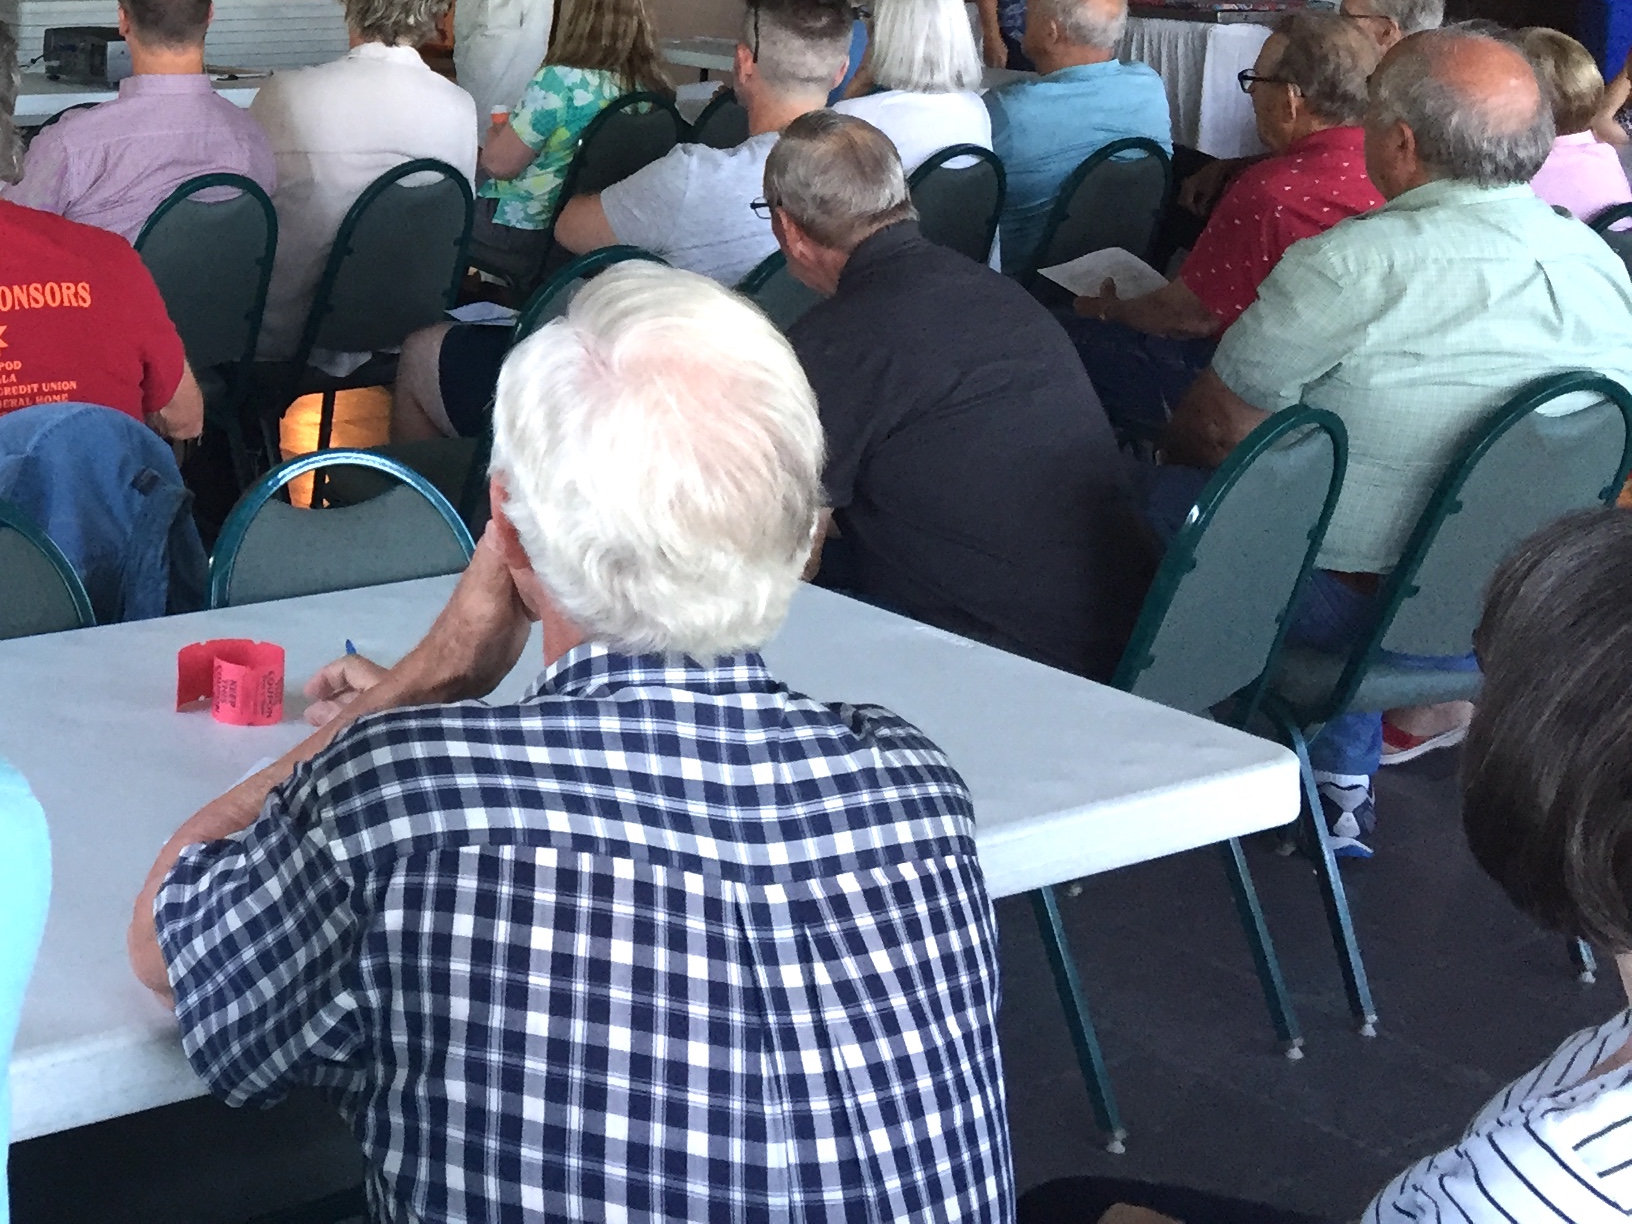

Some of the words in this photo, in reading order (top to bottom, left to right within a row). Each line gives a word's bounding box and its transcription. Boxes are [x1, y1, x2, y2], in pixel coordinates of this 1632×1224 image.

[42, 380, 77, 392] UNION
[35, 393, 69, 404] HOME
[267, 670, 275, 718] COUPON
